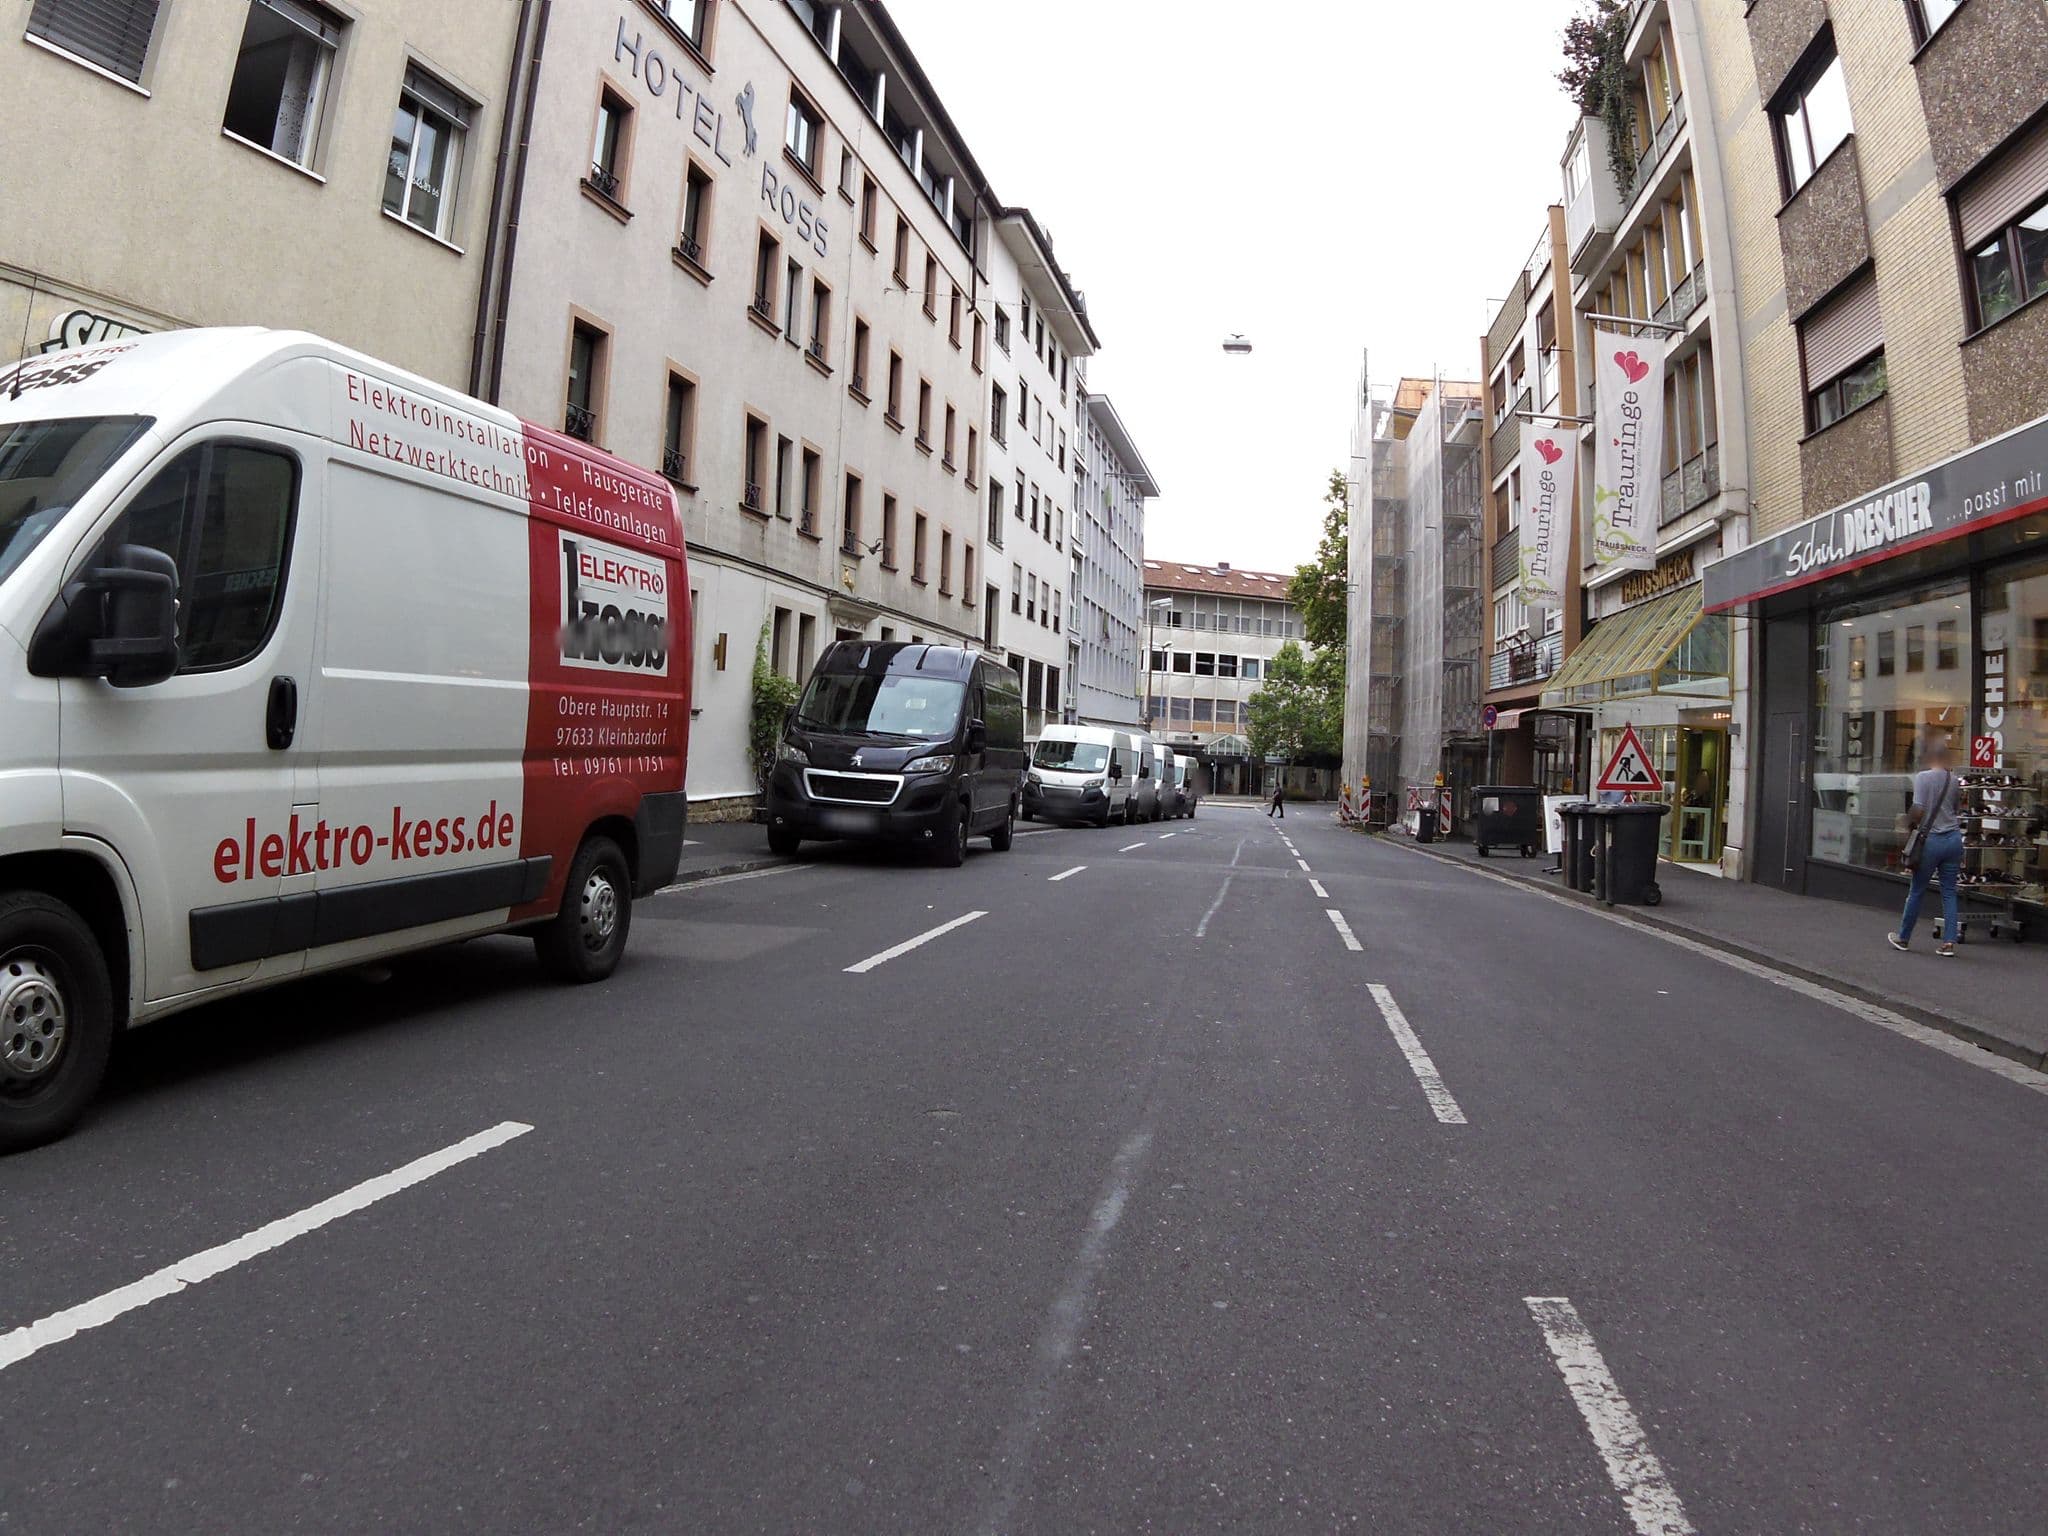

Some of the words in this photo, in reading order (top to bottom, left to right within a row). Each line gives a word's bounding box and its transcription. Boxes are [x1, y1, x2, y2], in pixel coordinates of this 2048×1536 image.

[615, 16, 731, 168] HOTEL
[761, 161, 828, 258] ROSS
[347, 373, 549, 469] Elektroinstallation
[582, 462, 663, 511] Hausgeräte
[350, 419, 533, 501] Netzwerktechnik
[553, 486, 667, 544] Telefonanlagen
[1612, 390, 1642, 529] Trauringe
[1530, 470, 1556, 577] Trauringe
[1843, 481, 1933, 556] DRESCHER
[2014, 470, 2042, 498] mir
[580, 553, 664, 594] ELEKTRO
[556, 727, 594, 746] 97633
[598, 727, 667, 745] Kleinbardorf
[559, 696, 596, 716] Obere
[601, 699, 652, 721] Hauptstr.
[657, 703, 668, 719] 14
[553, 757, 579, 776] Tel.
[584, 757, 622, 775] 09761
[638, 756, 664, 772] 1751
[213, 800, 515, 884] elektro-kess.de
